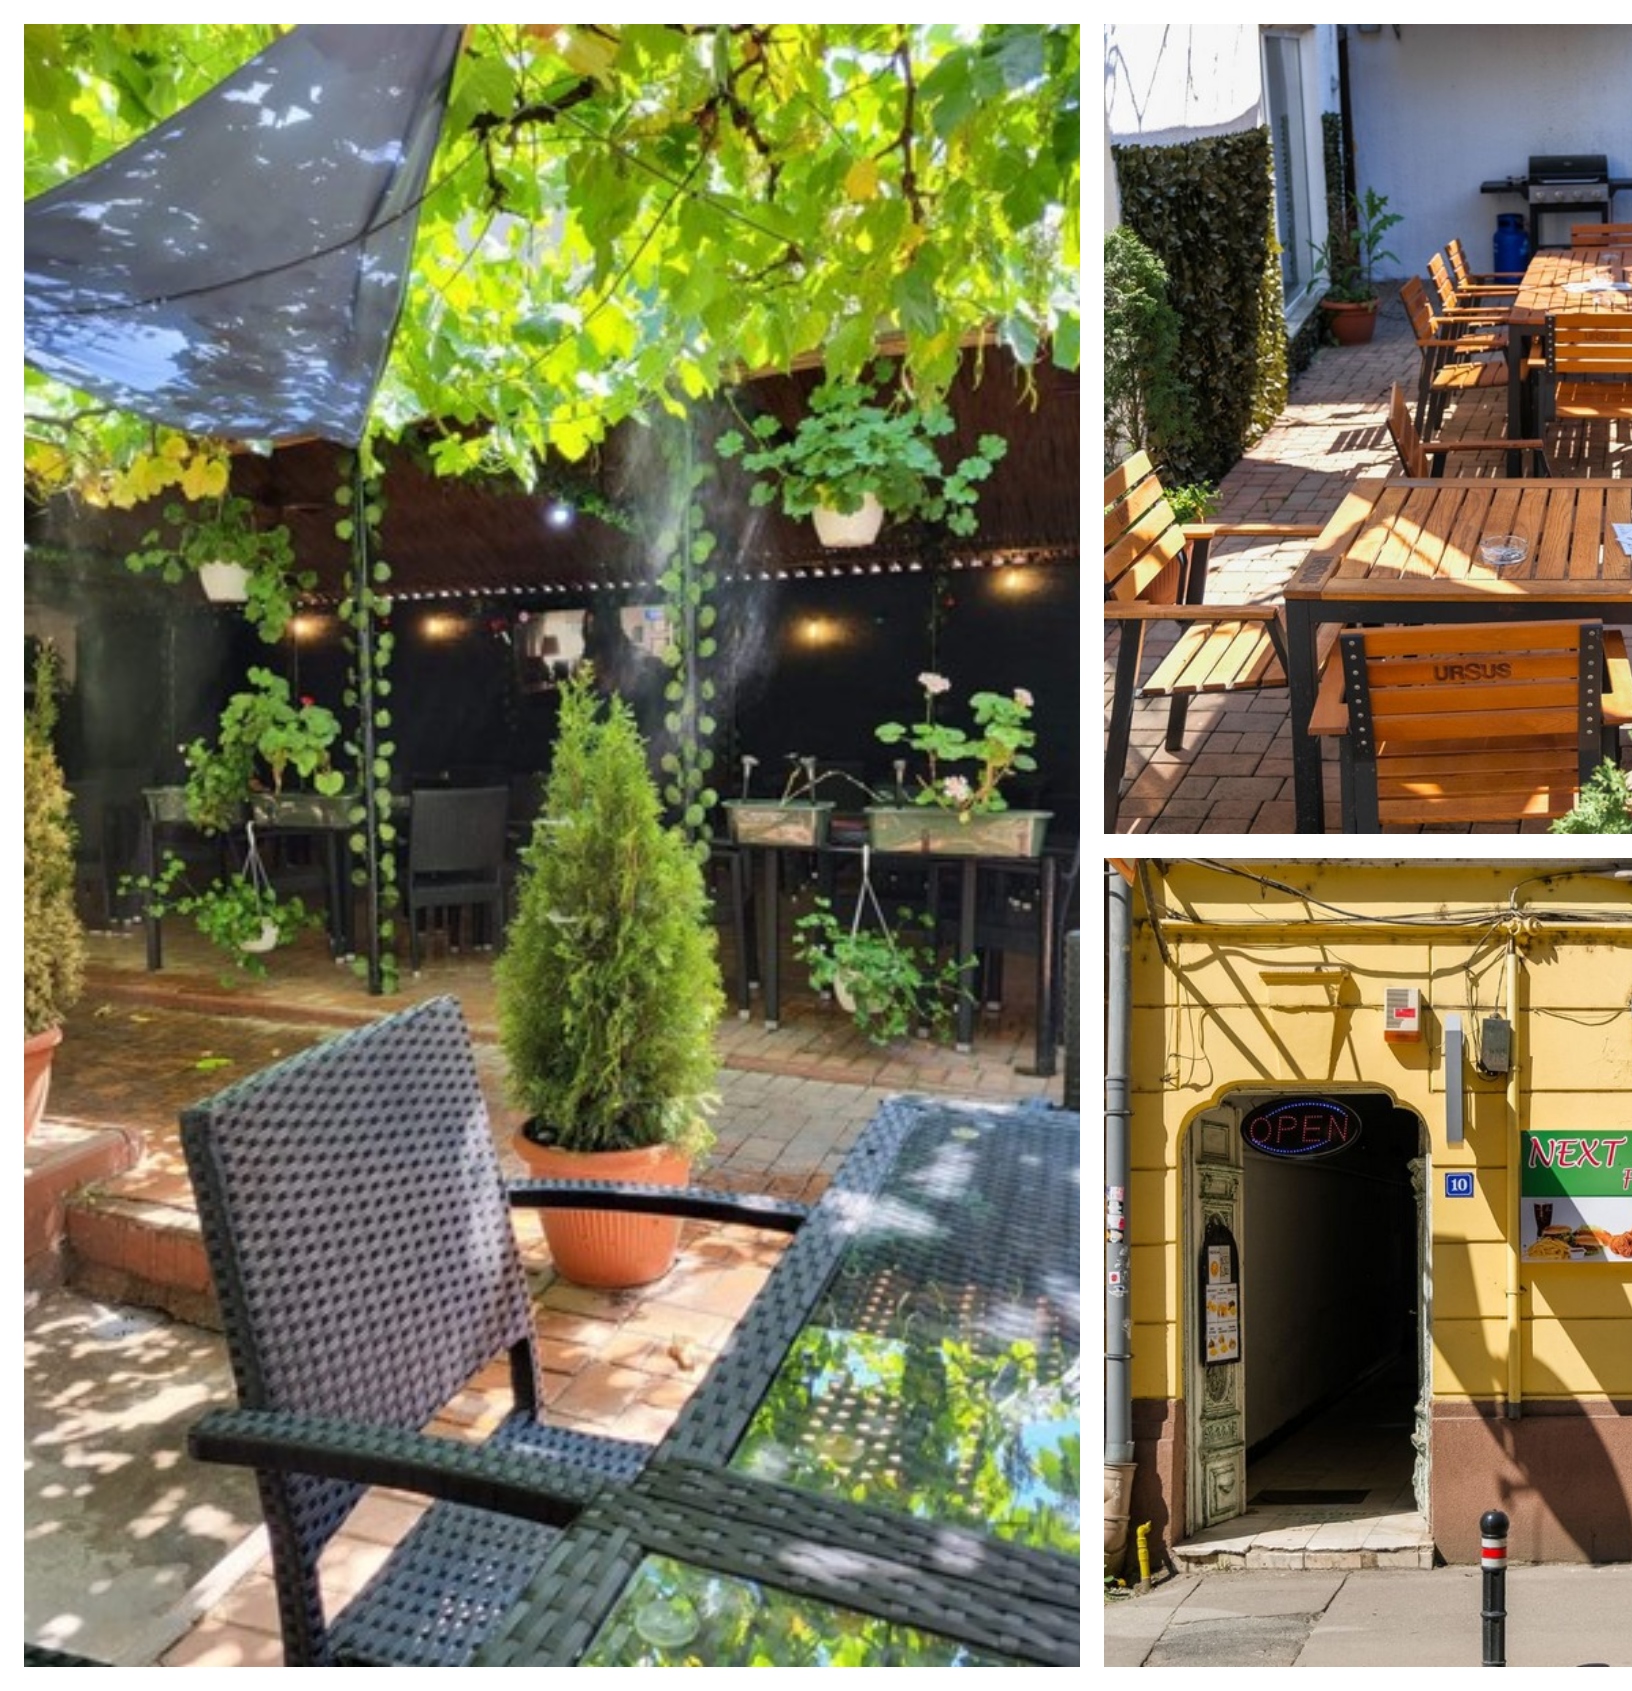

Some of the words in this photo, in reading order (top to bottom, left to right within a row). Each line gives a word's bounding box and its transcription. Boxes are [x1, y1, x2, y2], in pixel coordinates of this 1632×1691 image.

[1434, 662, 1512, 681] URSUS
[1250, 1114, 1349, 1143] OPEN
[1528, 1136, 1627, 1168] NEXT
[1450, 1178, 1468, 1192] 10
